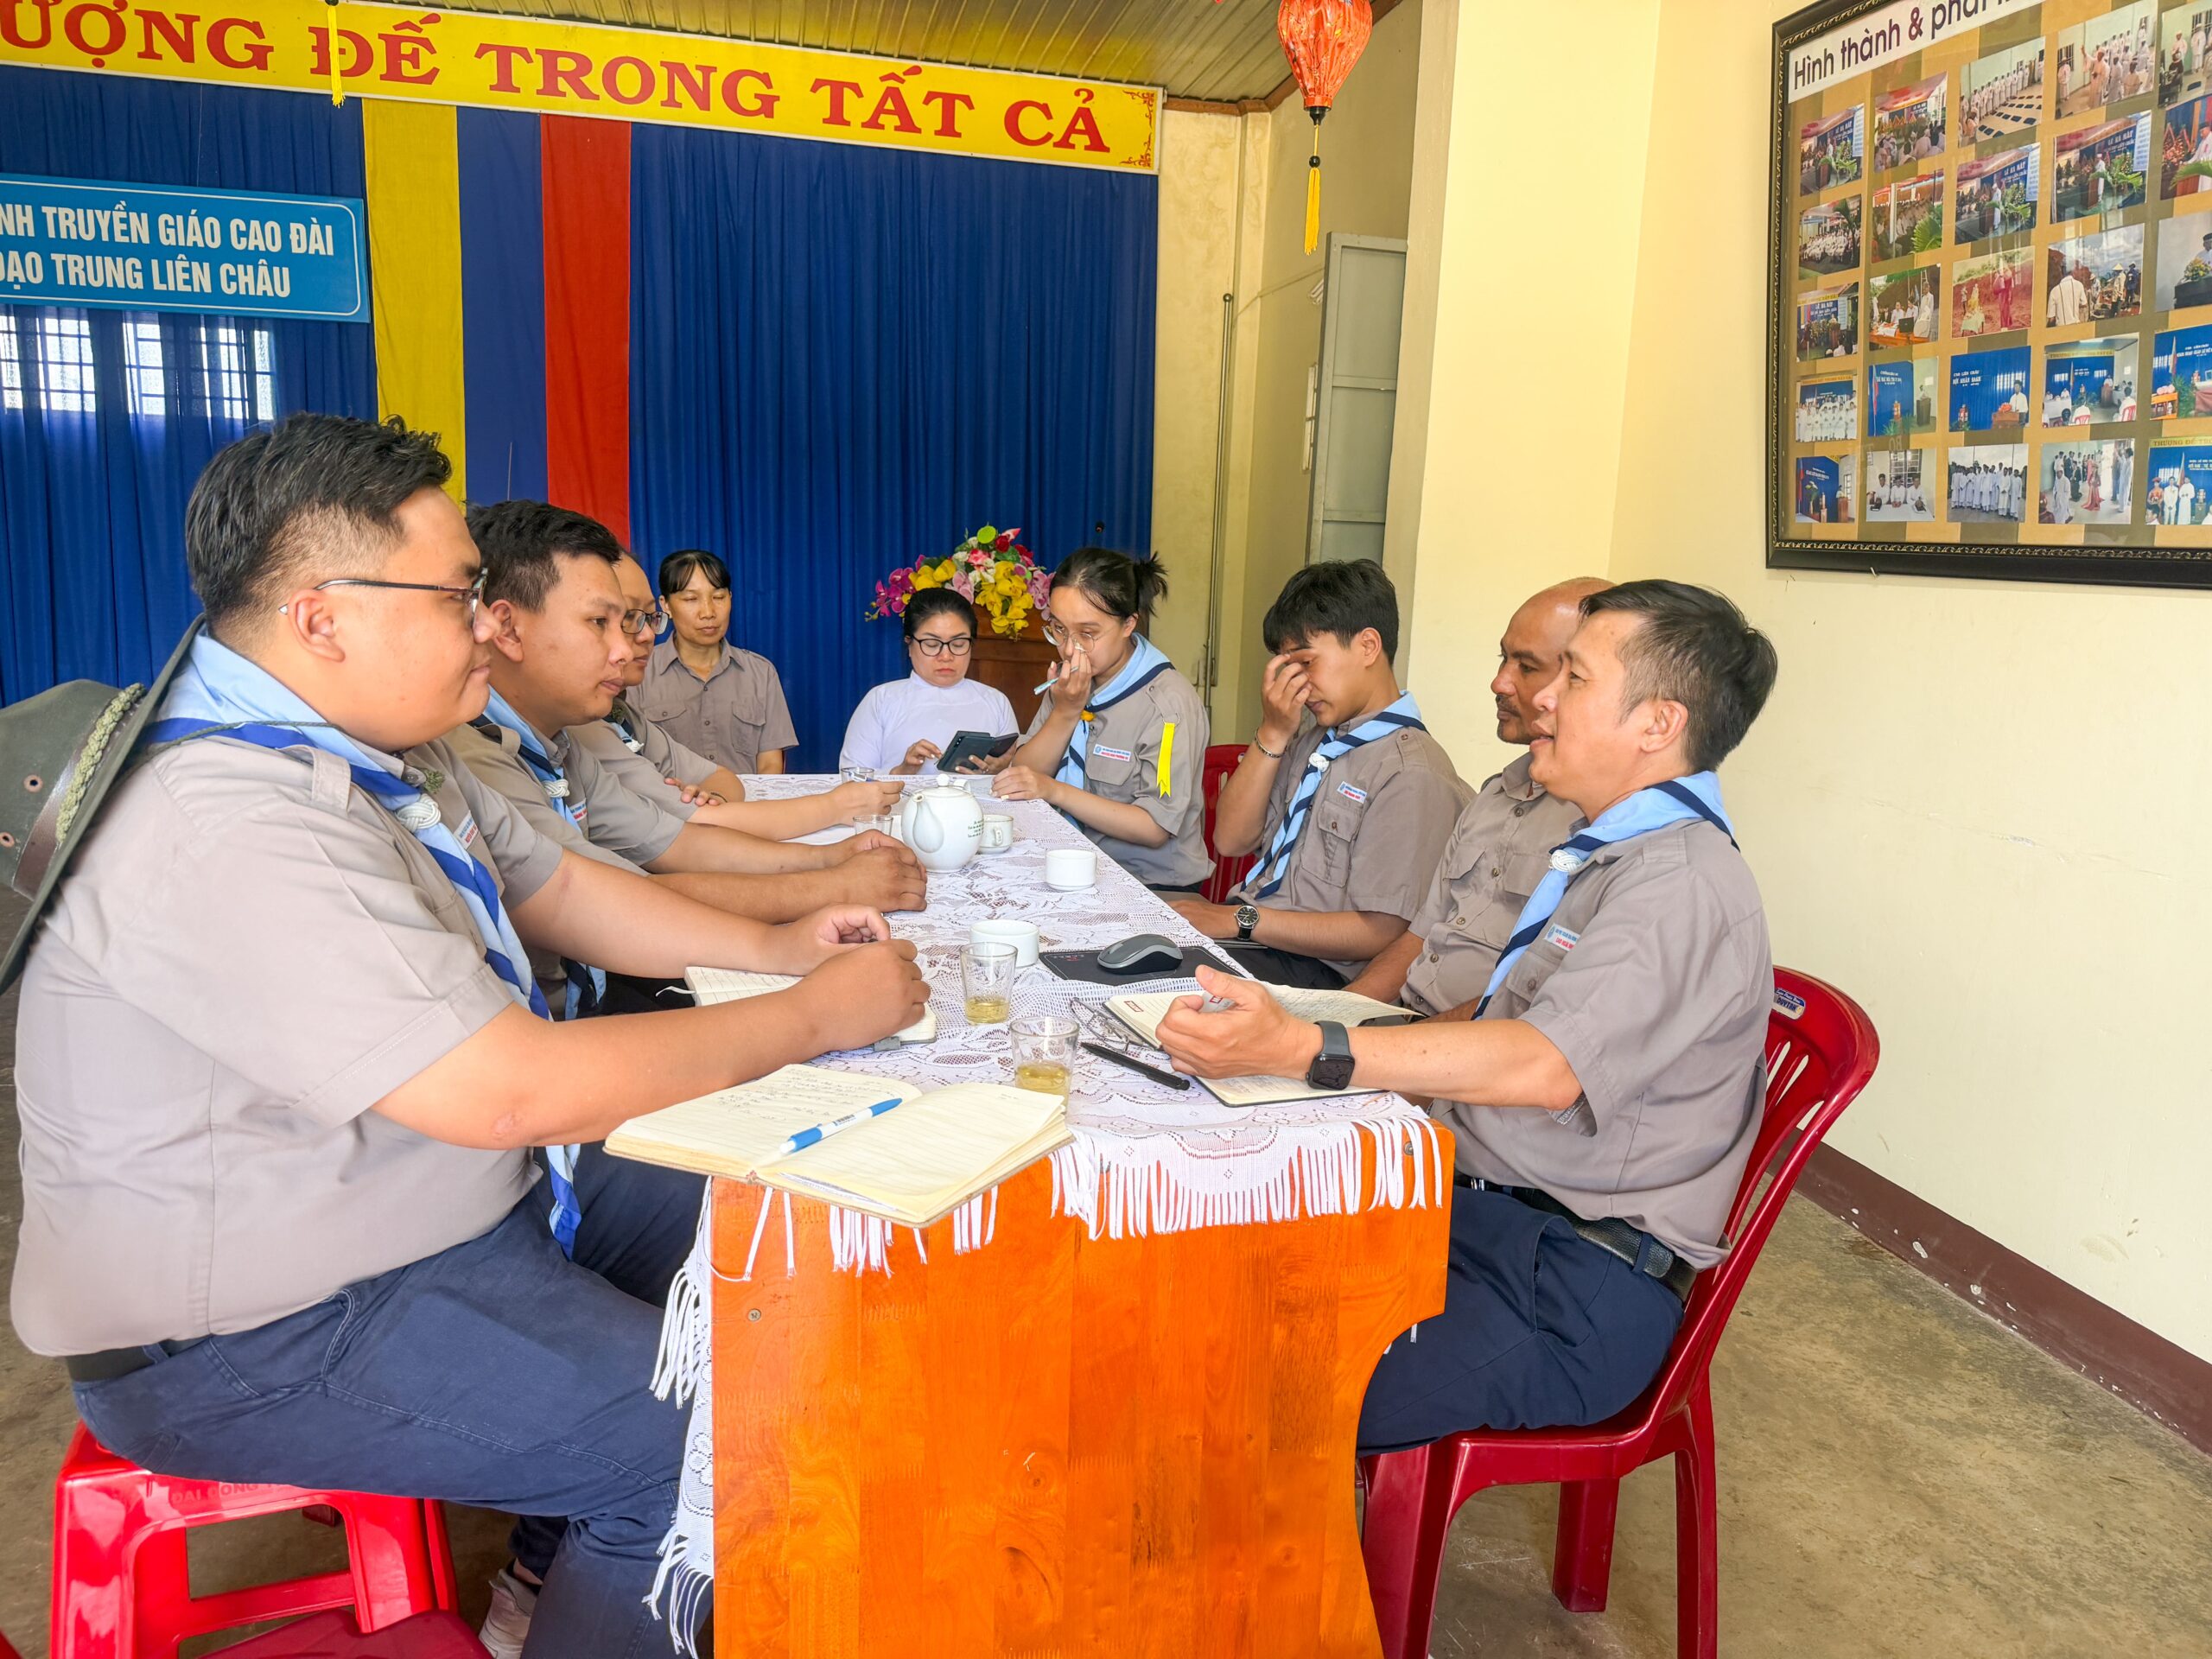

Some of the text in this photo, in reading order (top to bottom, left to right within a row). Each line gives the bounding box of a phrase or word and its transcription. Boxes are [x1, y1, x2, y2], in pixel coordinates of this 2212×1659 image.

[308, 13, 441, 85] ĐẾ
[474, 43, 780, 118] TRONG
[810, 65, 975, 138] TẤT
[1004, 88, 1110, 153] CẢ
[1794, 48, 1834, 90] Hình
[1840, 19, 1900, 70] thành
[1908, 7, 1923, 41] &
[41, 200, 150, 245] TRUYỀN
[159, 209, 221, 250] GIÁO
[230, 219, 282, 252] CAO
[289, 218, 334, 256] ĐÀI
[50, 252, 144, 289] TRUNG
[151, 254, 213, 293] LIÊN
[220, 259, 291, 298] CHÂU
